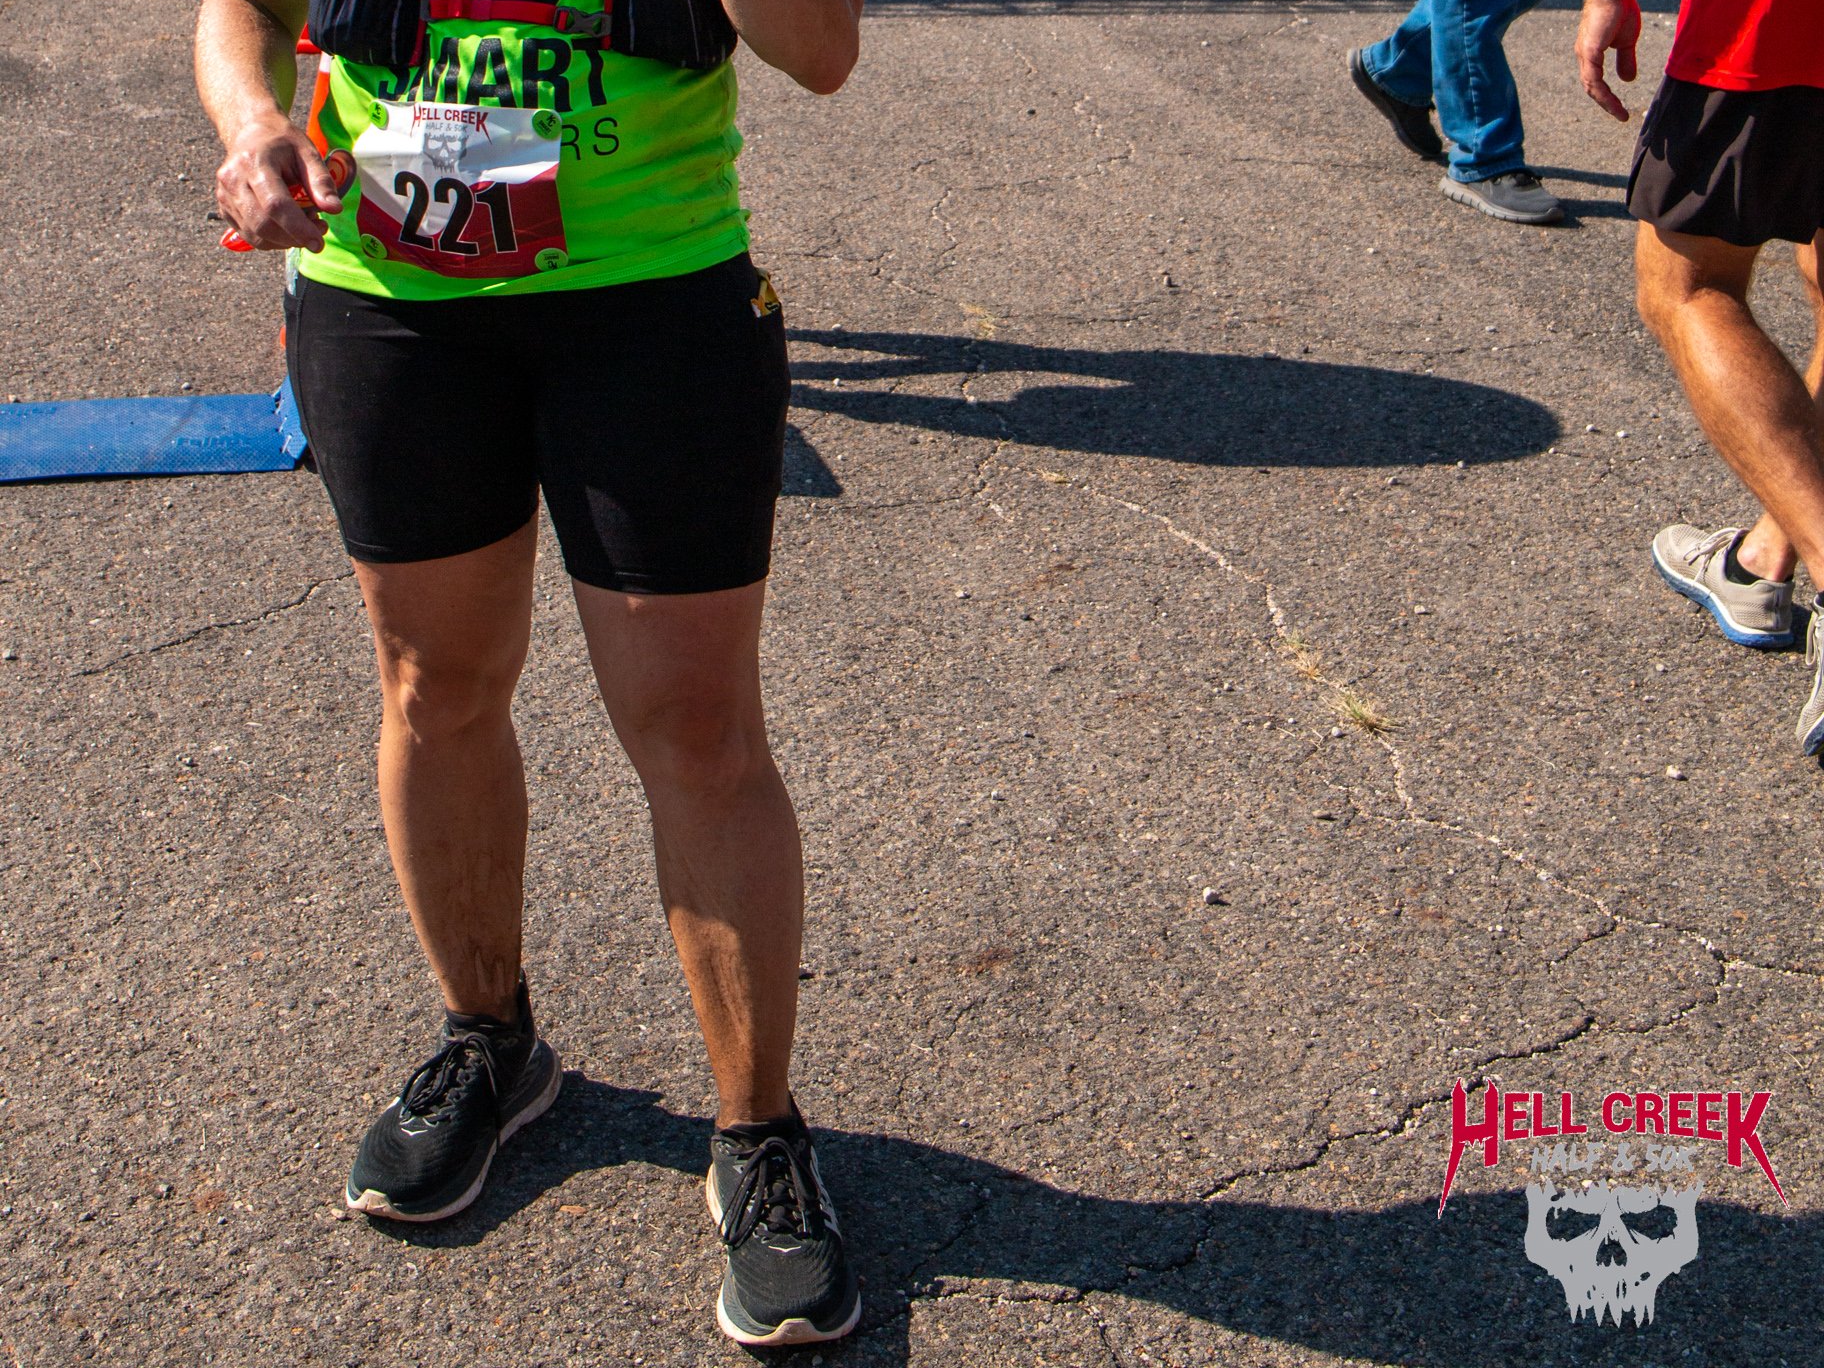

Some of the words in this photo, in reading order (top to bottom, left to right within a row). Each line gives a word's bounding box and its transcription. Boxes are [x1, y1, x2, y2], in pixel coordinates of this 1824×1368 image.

[411, 103, 441, 138] HELL
[444, 109, 492, 145] CREEK
[426, 121, 443, 130] HALF
[446, 122, 453, 131] &
[394, 171, 517, 255] 221
